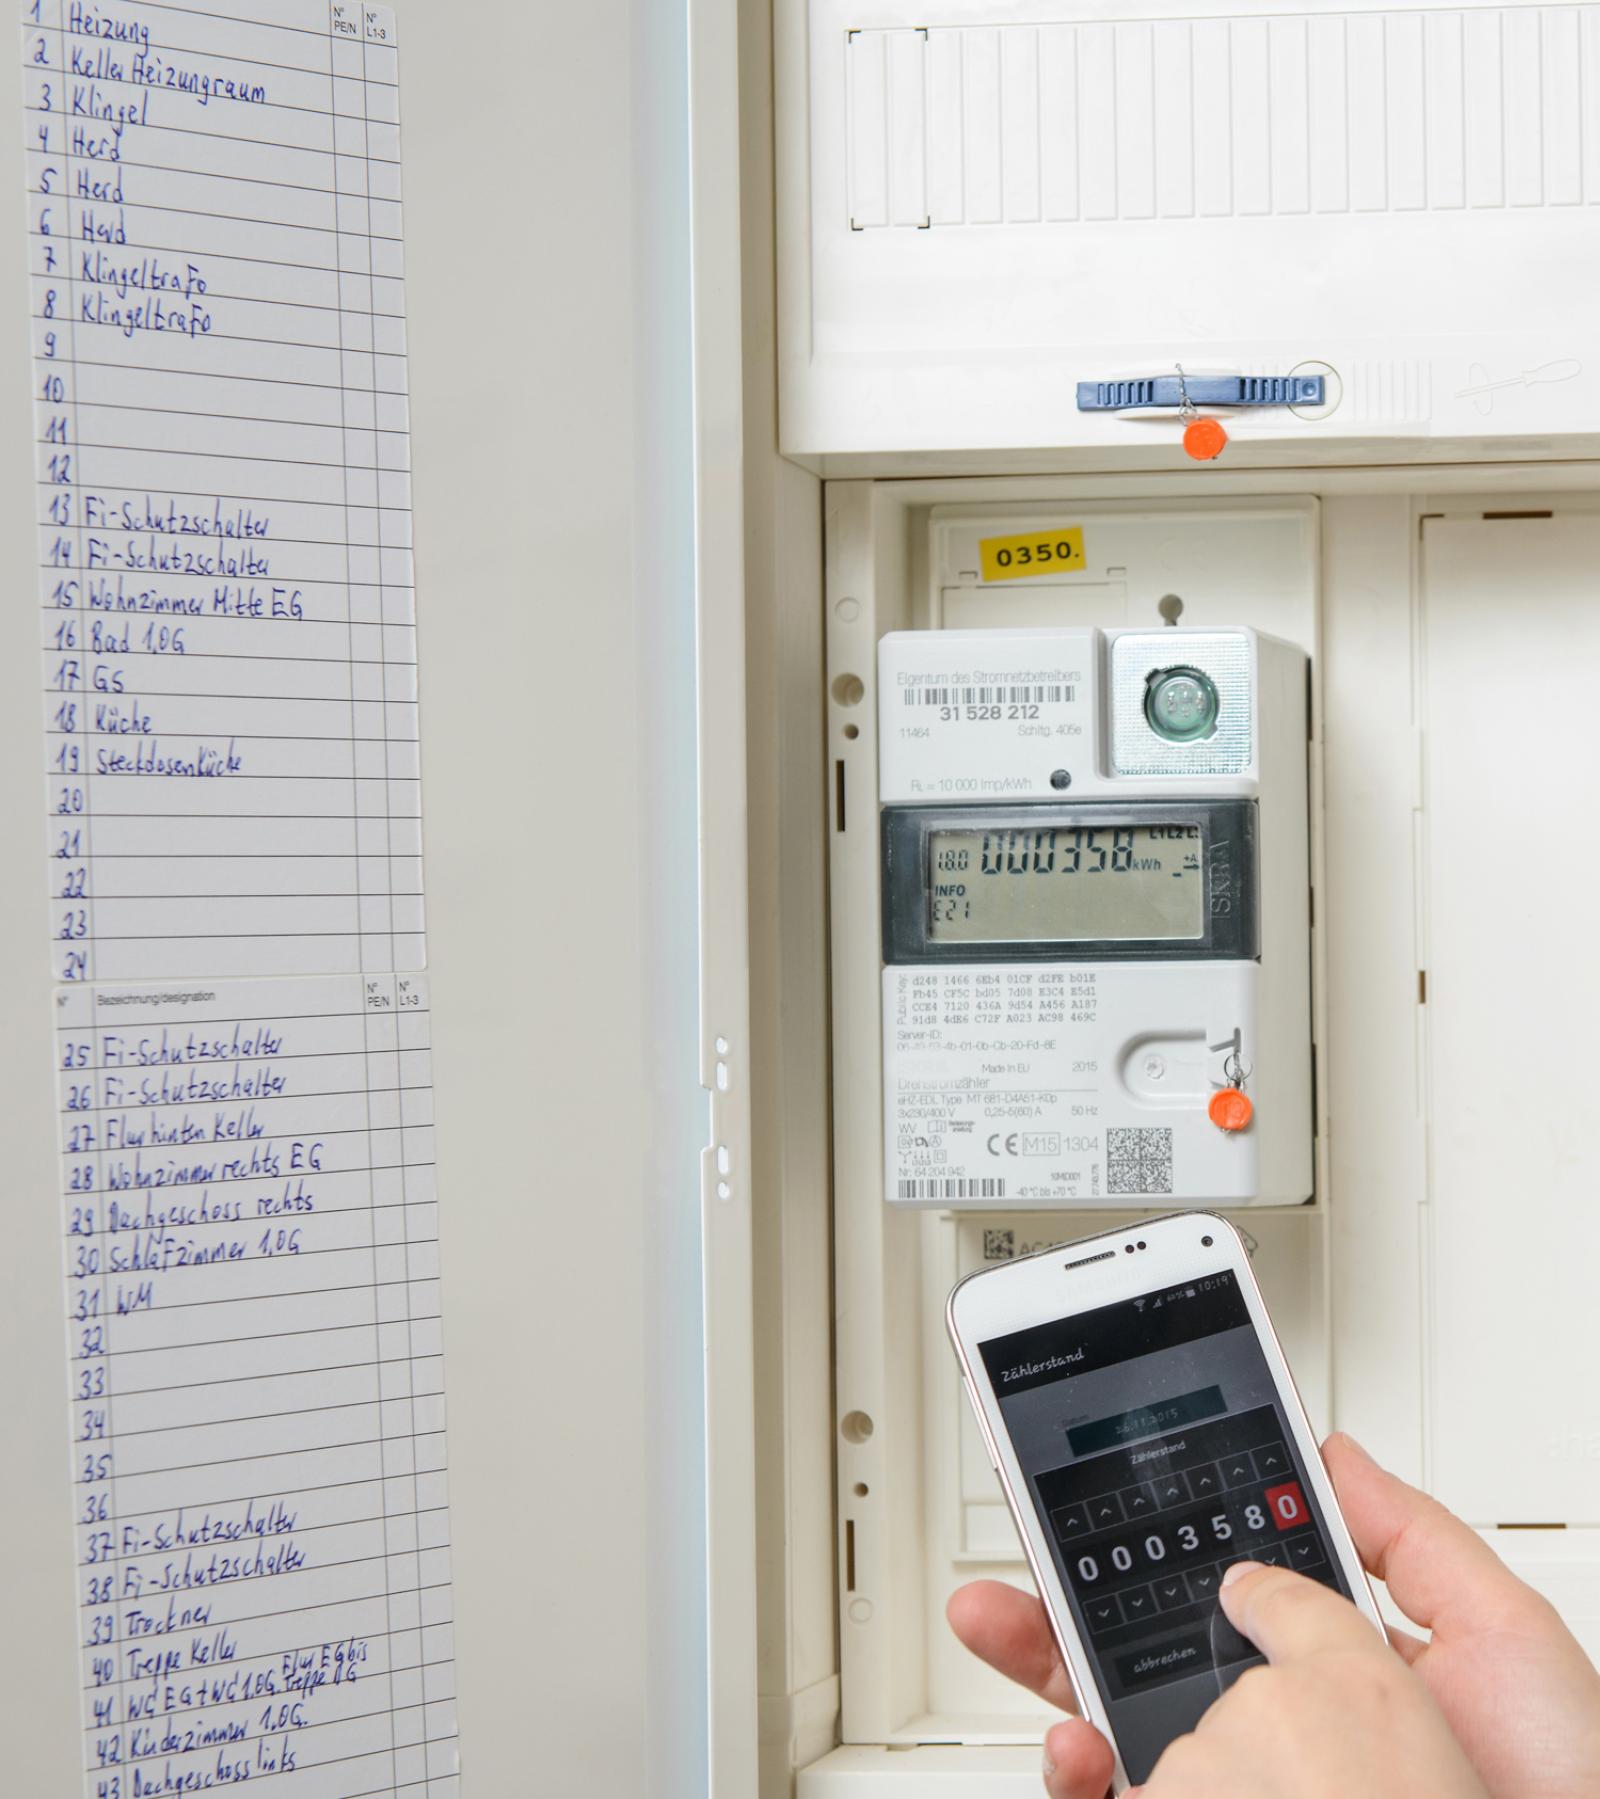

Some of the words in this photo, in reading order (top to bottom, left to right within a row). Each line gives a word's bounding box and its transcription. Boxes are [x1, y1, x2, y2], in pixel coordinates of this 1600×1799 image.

[69, 6, 151, 54] Heizung
[333, 21, 357, 34] PE/N
[366, 27, 386, 40] L1-3
[34, 39, 49, 64] 2
[38, 83, 52, 110] 3
[71, 84, 148, 136] Klingel
[38, 125, 48, 152] 4
[72, 125, 122, 162] Herd
[39, 168, 57, 193] 5
[77, 166, 124, 202] Herd
[44, 332, 56, 358] 9
[49, 494, 71, 526] 13
[271, 588, 303, 621] EG
[54, 660, 81, 692] 17
[93, 666, 125, 694] GS
[897, 671, 949, 686] Eigentum
[952, 670, 970, 683] des
[973, 669, 1081, 683] Stromnetzbetreibers
[55, 701, 76, 733] 18
[96, 699, 152, 735] Küche
[940, 706, 960, 721] 31
[967, 705, 1002, 720] 528
[1007, 704, 1039, 720] 212
[899, 727, 930, 739] 11464
[939, 778, 952, 791] 10
[954, 778, 978, 791] 000
[57, 788, 83, 814] 20
[1133, 858, 1162, 871] kWh
[935, 885, 966, 897] INFO
[61, 910, 87, 939] 23
[945, 976, 969, 986] 1466
[945, 1002, 970, 1011] 7120
[1039, 1000, 1065, 1010] A456
[1071, 1000, 1097, 1009] A187
[1006, 1014, 1032, 1023] A023
[1070, 1013, 1096, 1022] 469C
[62, 1043, 91, 1069] 25
[1072, 1061, 1098, 1072] 2015
[67, 1086, 91, 1110] 26
[1025, 1137, 1058, 1151] M15
[1064, 1136, 1098, 1150] 1304
[222, 1144, 281, 1178] rechts
[291, 1143, 324, 1172] EG
[75, 1289, 100, 1320] 31
[116, 1282, 153, 1317] WM
[1001, 1347, 1085, 1383] Zählerstand
[79, 1368, 105, 1400] 33
[1130, 1440, 1186, 1466] Zählerstand
[86, 1533, 115, 1564] 37
[87, 1578, 113, 1605] 38
[88, 1618, 113, 1646] 39
[1134, 1647, 1196, 1674] abbrechen
